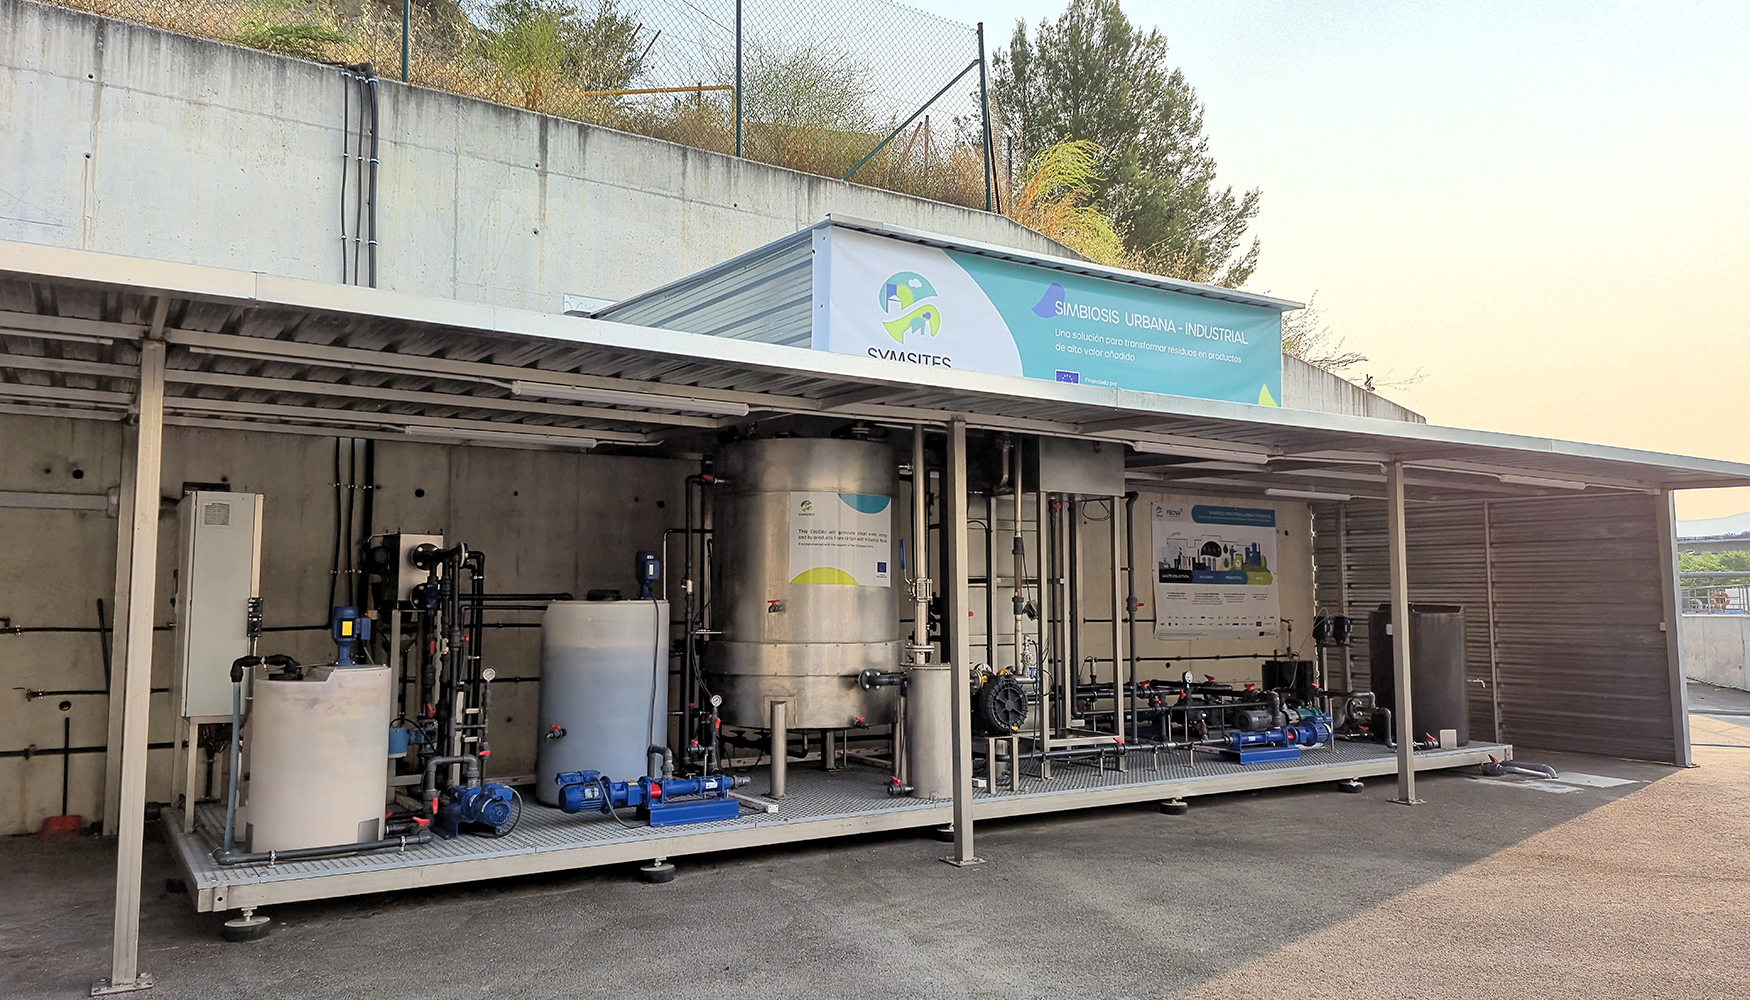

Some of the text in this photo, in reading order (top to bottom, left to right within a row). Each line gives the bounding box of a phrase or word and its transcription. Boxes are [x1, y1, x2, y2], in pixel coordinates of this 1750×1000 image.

[1055, 300, 1120, 324] SIMBIOSIS
[1125, 312, 1176, 333] URBANA
[1185, 322, 1249, 345] INDUSTRIAL
[1054, 328, 1242, 364] Una solución para transformar residuos en productos
[1055, 343, 1135, 362] de alto valor añadido
[1084, 376, 1110, 387] Financiado
